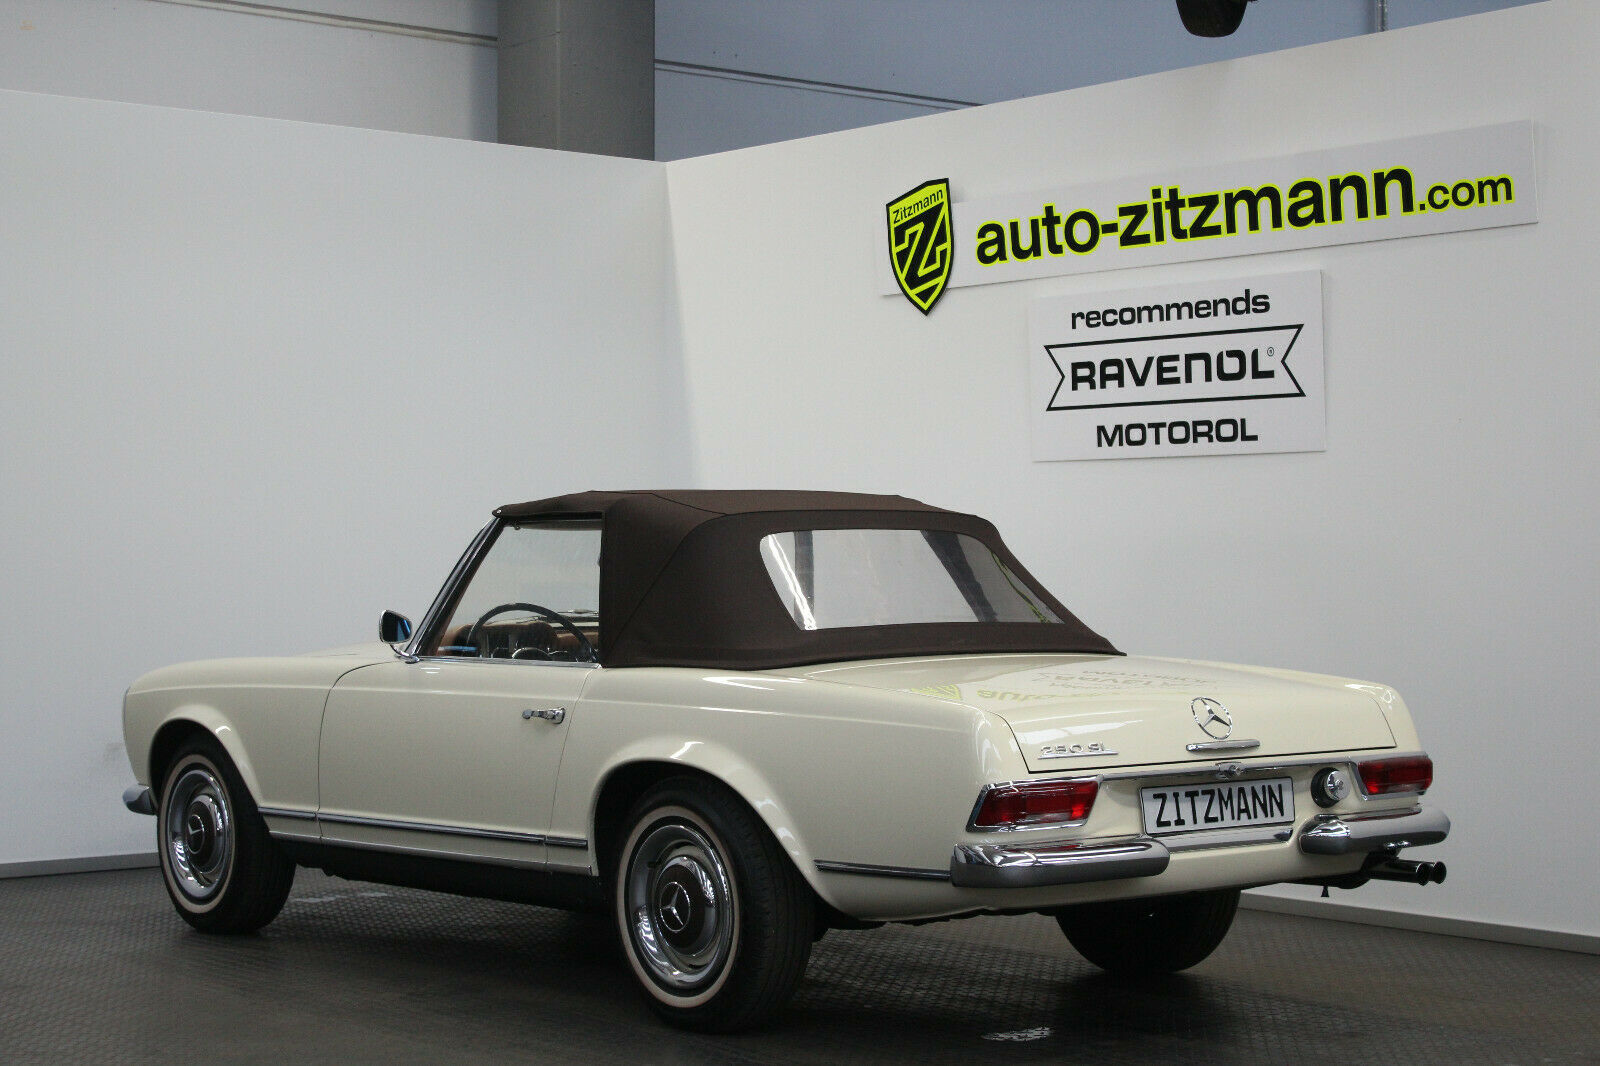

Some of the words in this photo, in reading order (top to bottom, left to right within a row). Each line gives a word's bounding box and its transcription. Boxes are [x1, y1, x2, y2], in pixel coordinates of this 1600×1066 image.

[892, 189, 943, 223] Zitzmann
[976, 167, 1514, 265] auto-zitzmann.com
[1071, 289, 1271, 330] recommends
[1096, 418, 1259, 448] MOTOROL
[1153, 784, 1284, 827] ZITZMANN
